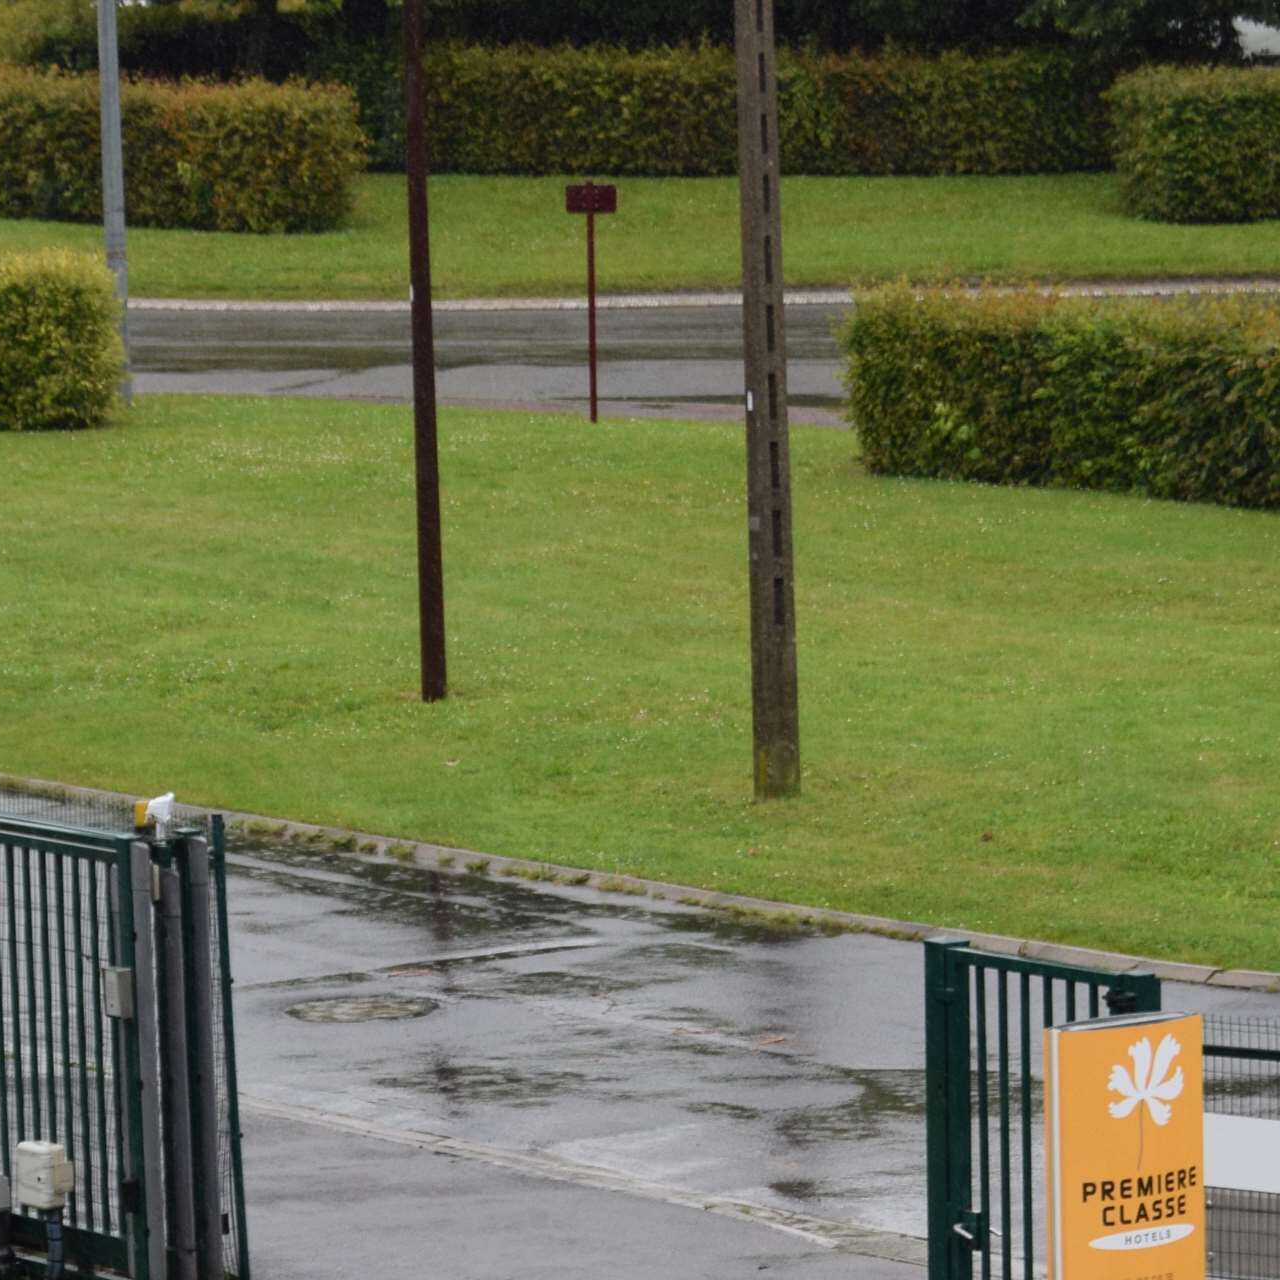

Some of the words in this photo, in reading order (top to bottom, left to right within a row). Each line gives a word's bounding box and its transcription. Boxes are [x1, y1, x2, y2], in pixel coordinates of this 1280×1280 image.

[1082, 1166, 1196, 1203] PREMIERE
[1102, 1195, 1186, 1226] CLASSE
[1124, 1229, 1171, 1245] HOTELS
